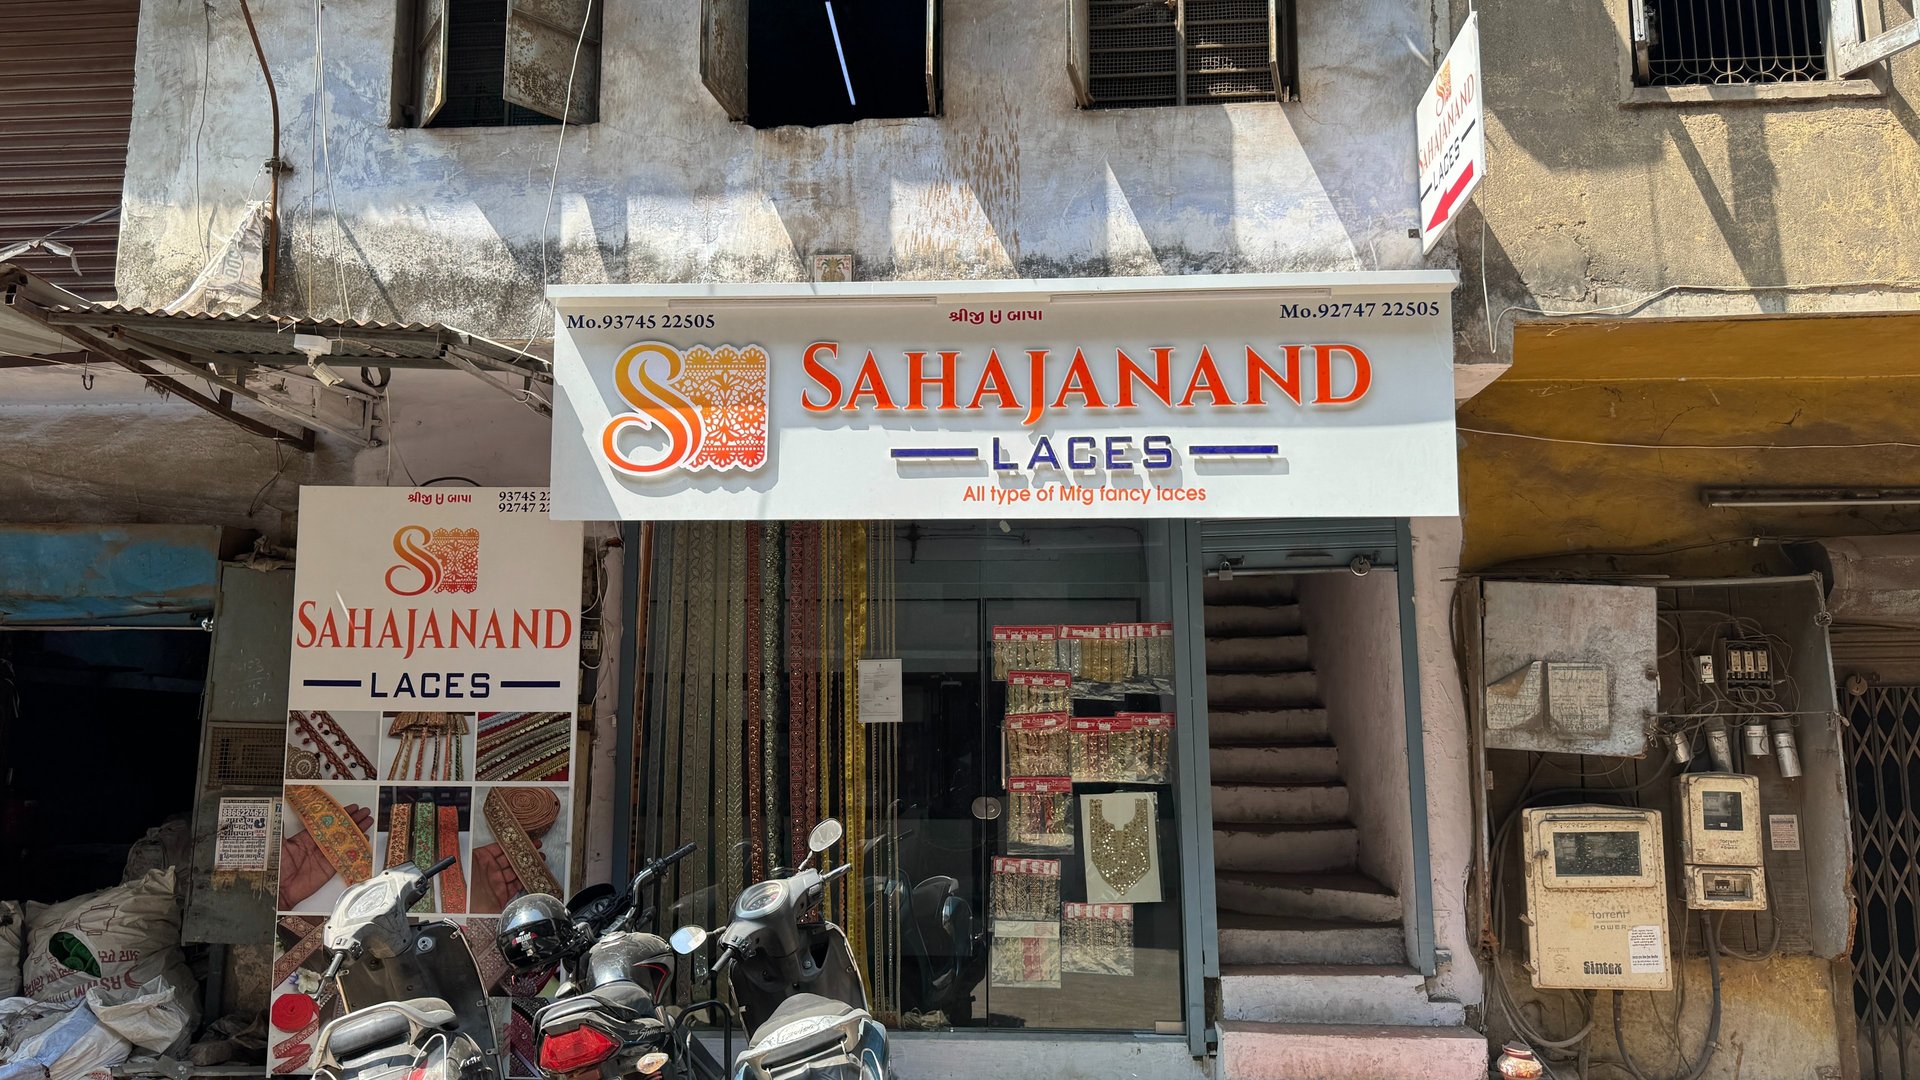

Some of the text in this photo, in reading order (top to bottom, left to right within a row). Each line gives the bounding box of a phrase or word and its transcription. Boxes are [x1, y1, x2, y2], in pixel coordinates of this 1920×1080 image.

[1419, 73, 1475, 180] SAHAJANAND
[1432, 136, 1461, 192] LACES
[949, 308, 1043, 325] શ્રીજી બાપા
[1280, 301, 1440, 319] Mo.92747 22505
[567, 314, 715, 330] Mo.93745 22505
[801, 341, 1373, 426] SAHAJANAND
[992, 434, 1173, 471] LACES
[407, 491, 472, 505] શ્રીજી બાપા
[499, 491, 536, 501] 93745
[963, 484, 1207, 506] All type of Mfg fancy laces
[498, 502, 536, 512] 92747
[296, 600, 572, 659] SAHAJANAND
[370, 672, 490, 698] LACES
[1589, 909, 1630, 920] torrent
[1583, 961, 1623, 975] Sintex
